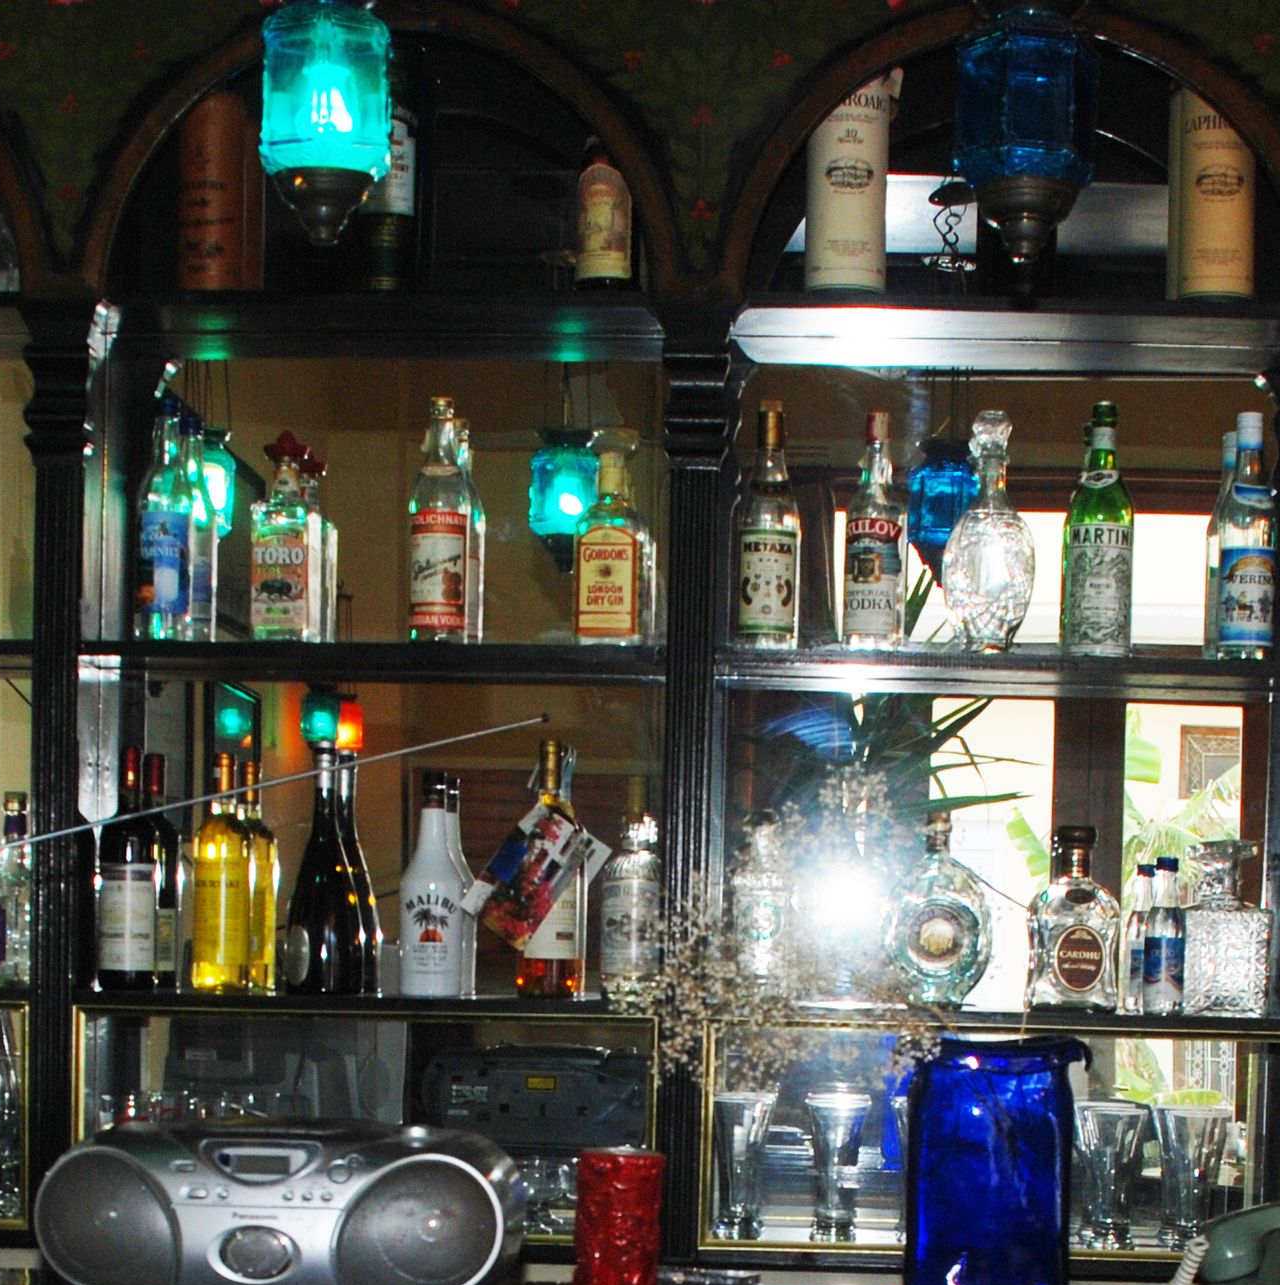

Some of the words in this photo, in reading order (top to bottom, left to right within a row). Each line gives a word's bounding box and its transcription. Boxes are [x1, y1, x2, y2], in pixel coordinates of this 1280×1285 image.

[1073, 528, 1129, 546] MARTIN
[255, 547, 304, 565] TORO
[743, 541, 793, 556] METAXA
[587, 585, 623, 594] LONDON
[586, 595, 605, 606] DRY
[607, 595, 624, 606] GIN
[405, 893, 458, 914] MALIBU
[1059, 950, 1101, 961] CARDHU
